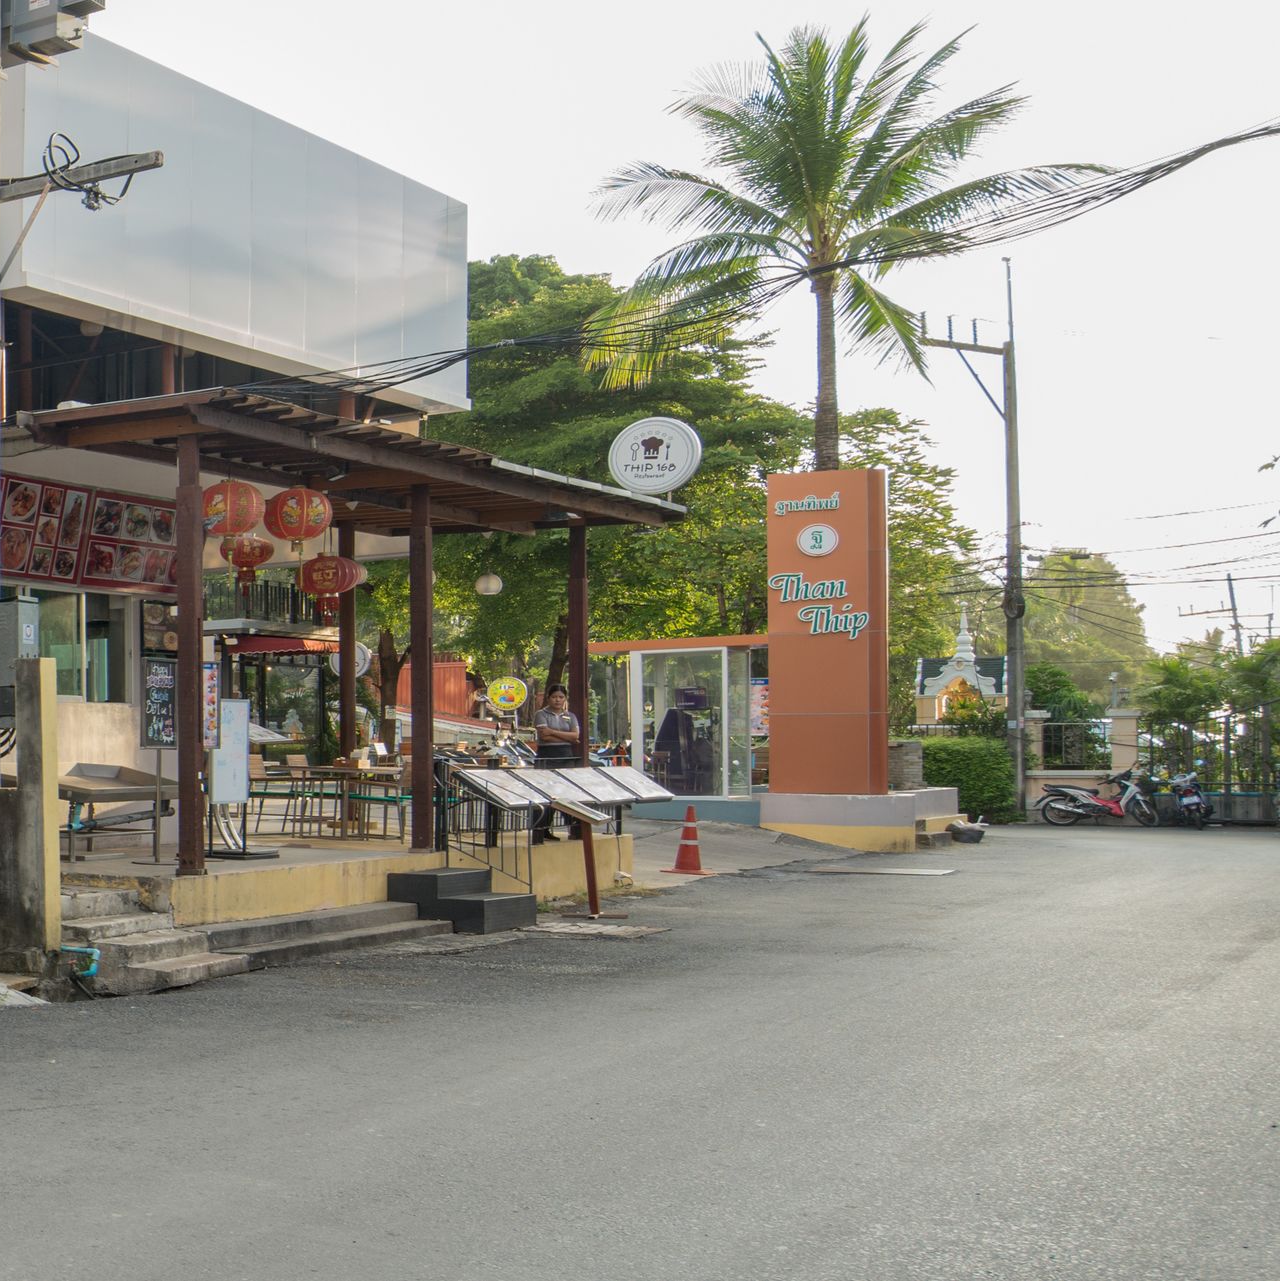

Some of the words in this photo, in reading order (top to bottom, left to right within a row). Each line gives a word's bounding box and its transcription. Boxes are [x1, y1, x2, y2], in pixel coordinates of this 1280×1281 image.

[623, 462, 654, 473] THIP
[657, 462, 677, 472] 168
[768, 572, 847, 603] Than
[797, 604, 870, 640] Thip
